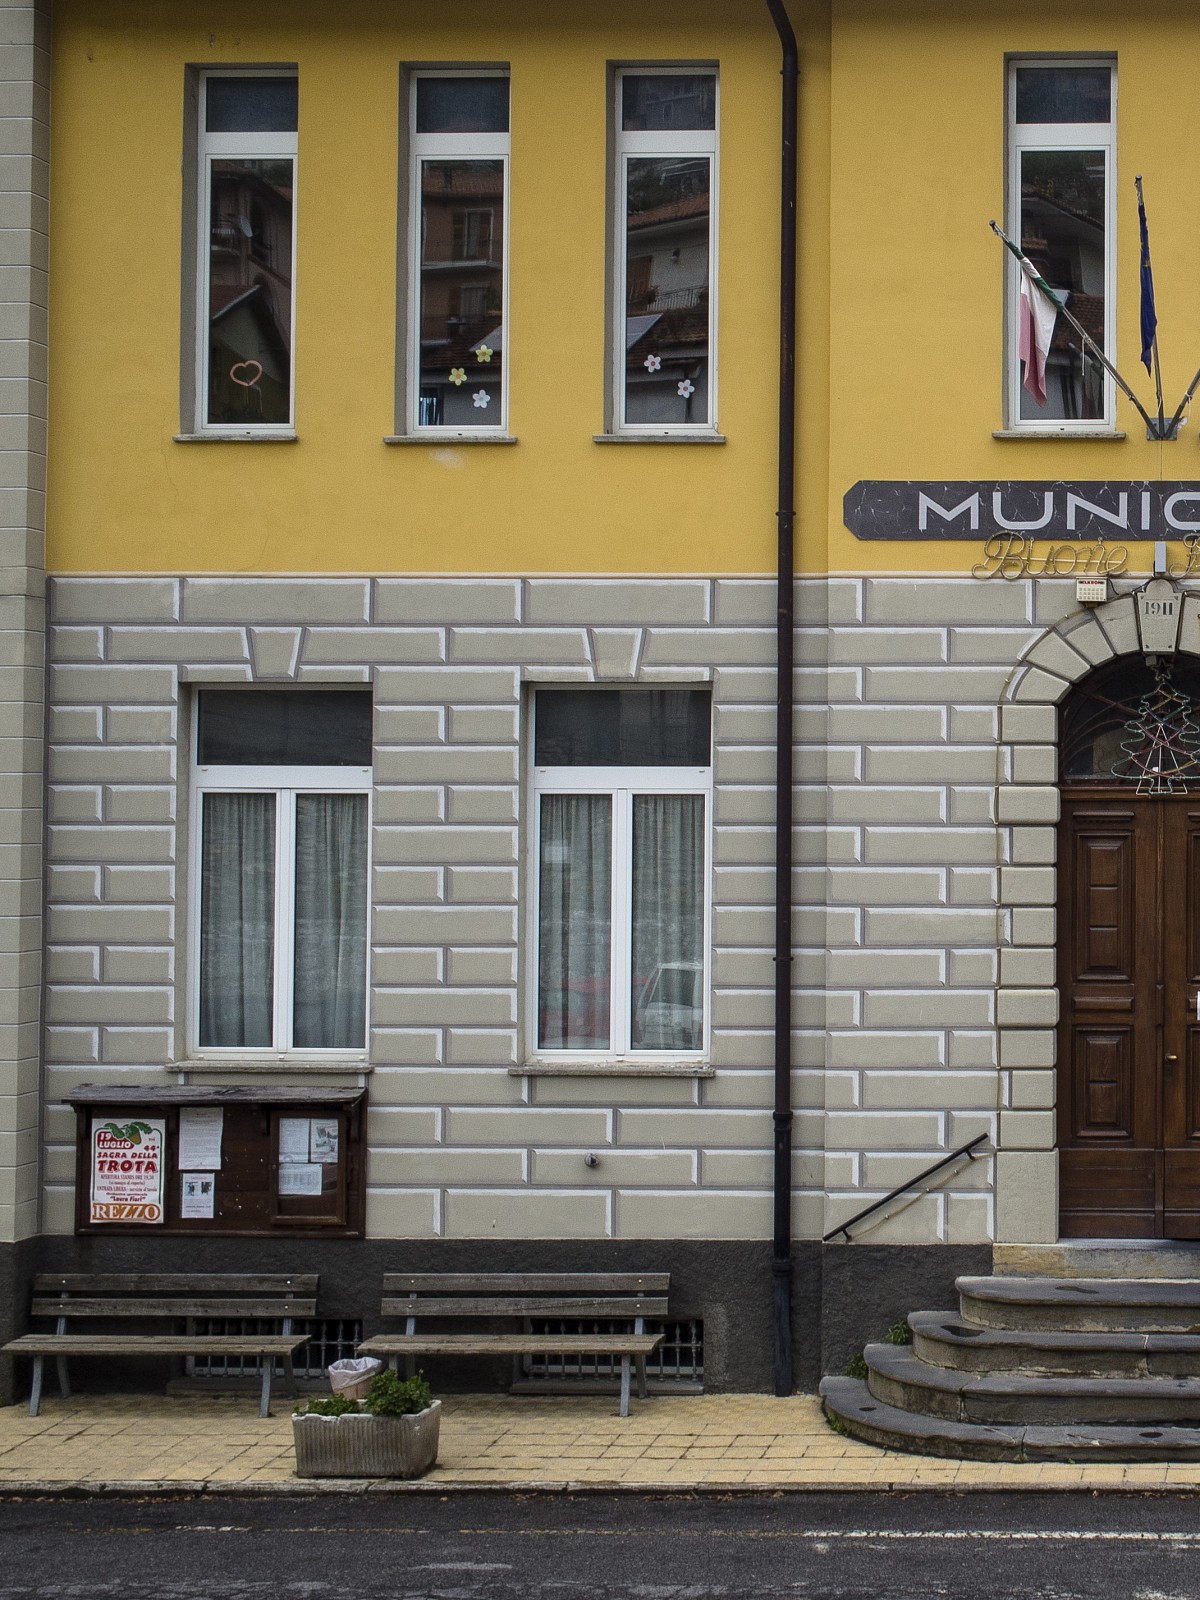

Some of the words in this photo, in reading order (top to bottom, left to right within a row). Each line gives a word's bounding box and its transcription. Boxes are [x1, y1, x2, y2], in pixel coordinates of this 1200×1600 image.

[971, 530, 1129, 579] Buone
[1145, 601, 1173, 616] 1911
[100, 1132, 112, 1140] 19
[99, 1140, 131, 1149] LUGLIO
[96, 1151, 127, 1159] SAGRA
[97, 1160, 158, 1173] TROTA
[93, 1203, 159, 1220] REZZO
